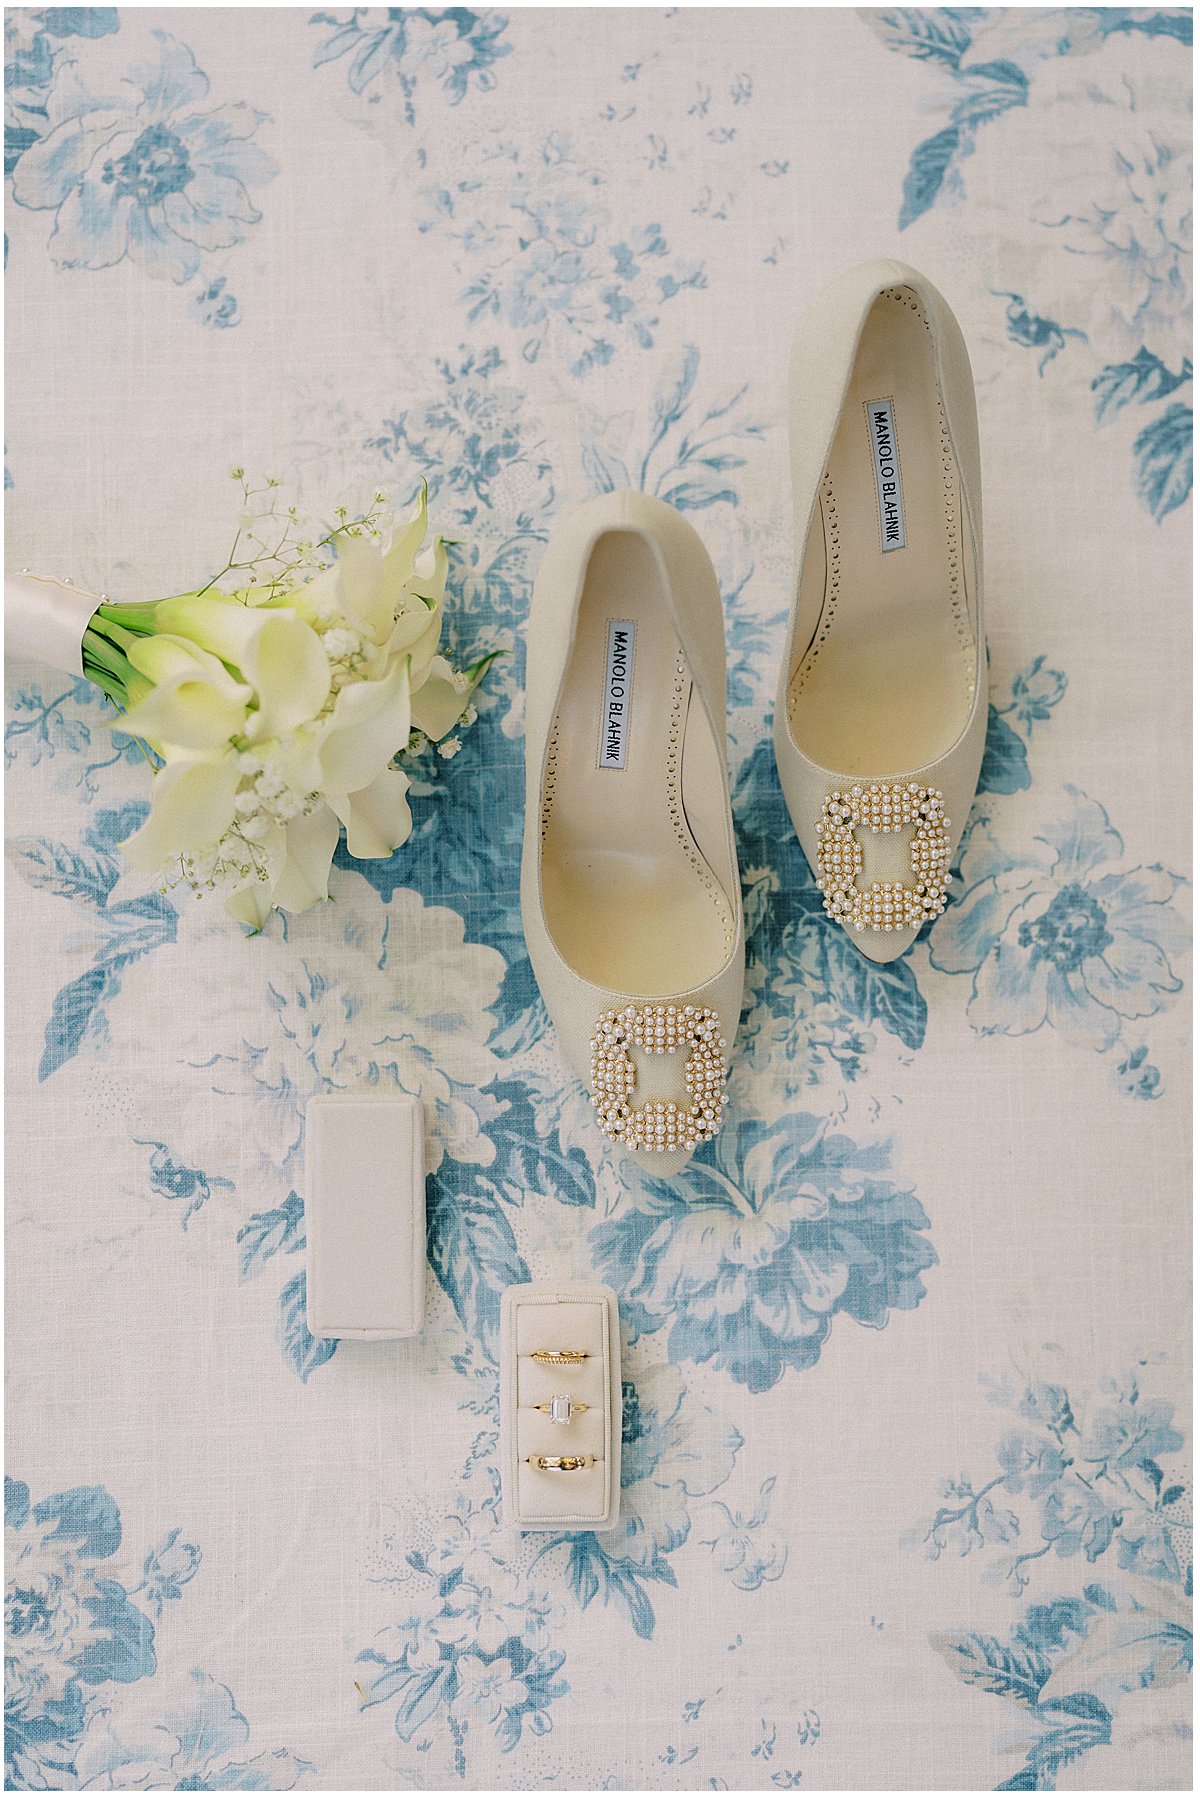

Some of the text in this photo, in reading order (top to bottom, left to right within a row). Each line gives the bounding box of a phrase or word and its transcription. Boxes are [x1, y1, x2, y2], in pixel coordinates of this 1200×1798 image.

[873, 410, 900, 542] MANOLO BLAHNIK
[606, 630, 628, 761] MANOLO BLAHNIK
